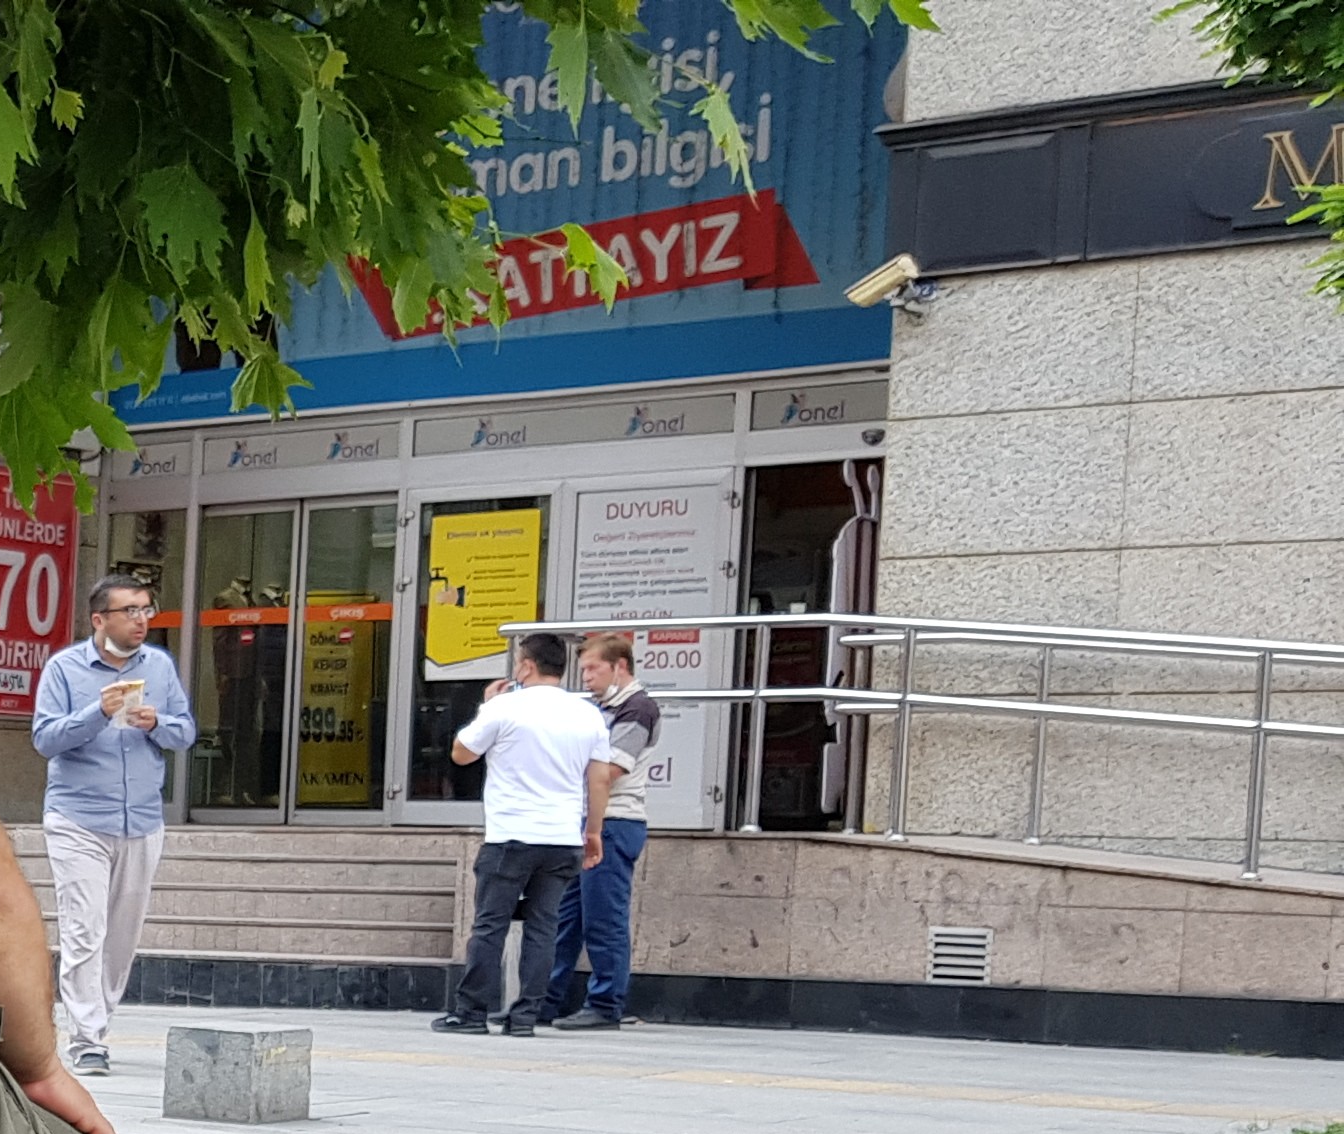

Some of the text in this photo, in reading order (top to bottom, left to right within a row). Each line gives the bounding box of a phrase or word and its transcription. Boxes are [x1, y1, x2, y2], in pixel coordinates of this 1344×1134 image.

[601, 93, 771, 189] bilgii
[432, 212, 743, 324] ATAYIZ
[607, 499, 688, 520] DUYURU
